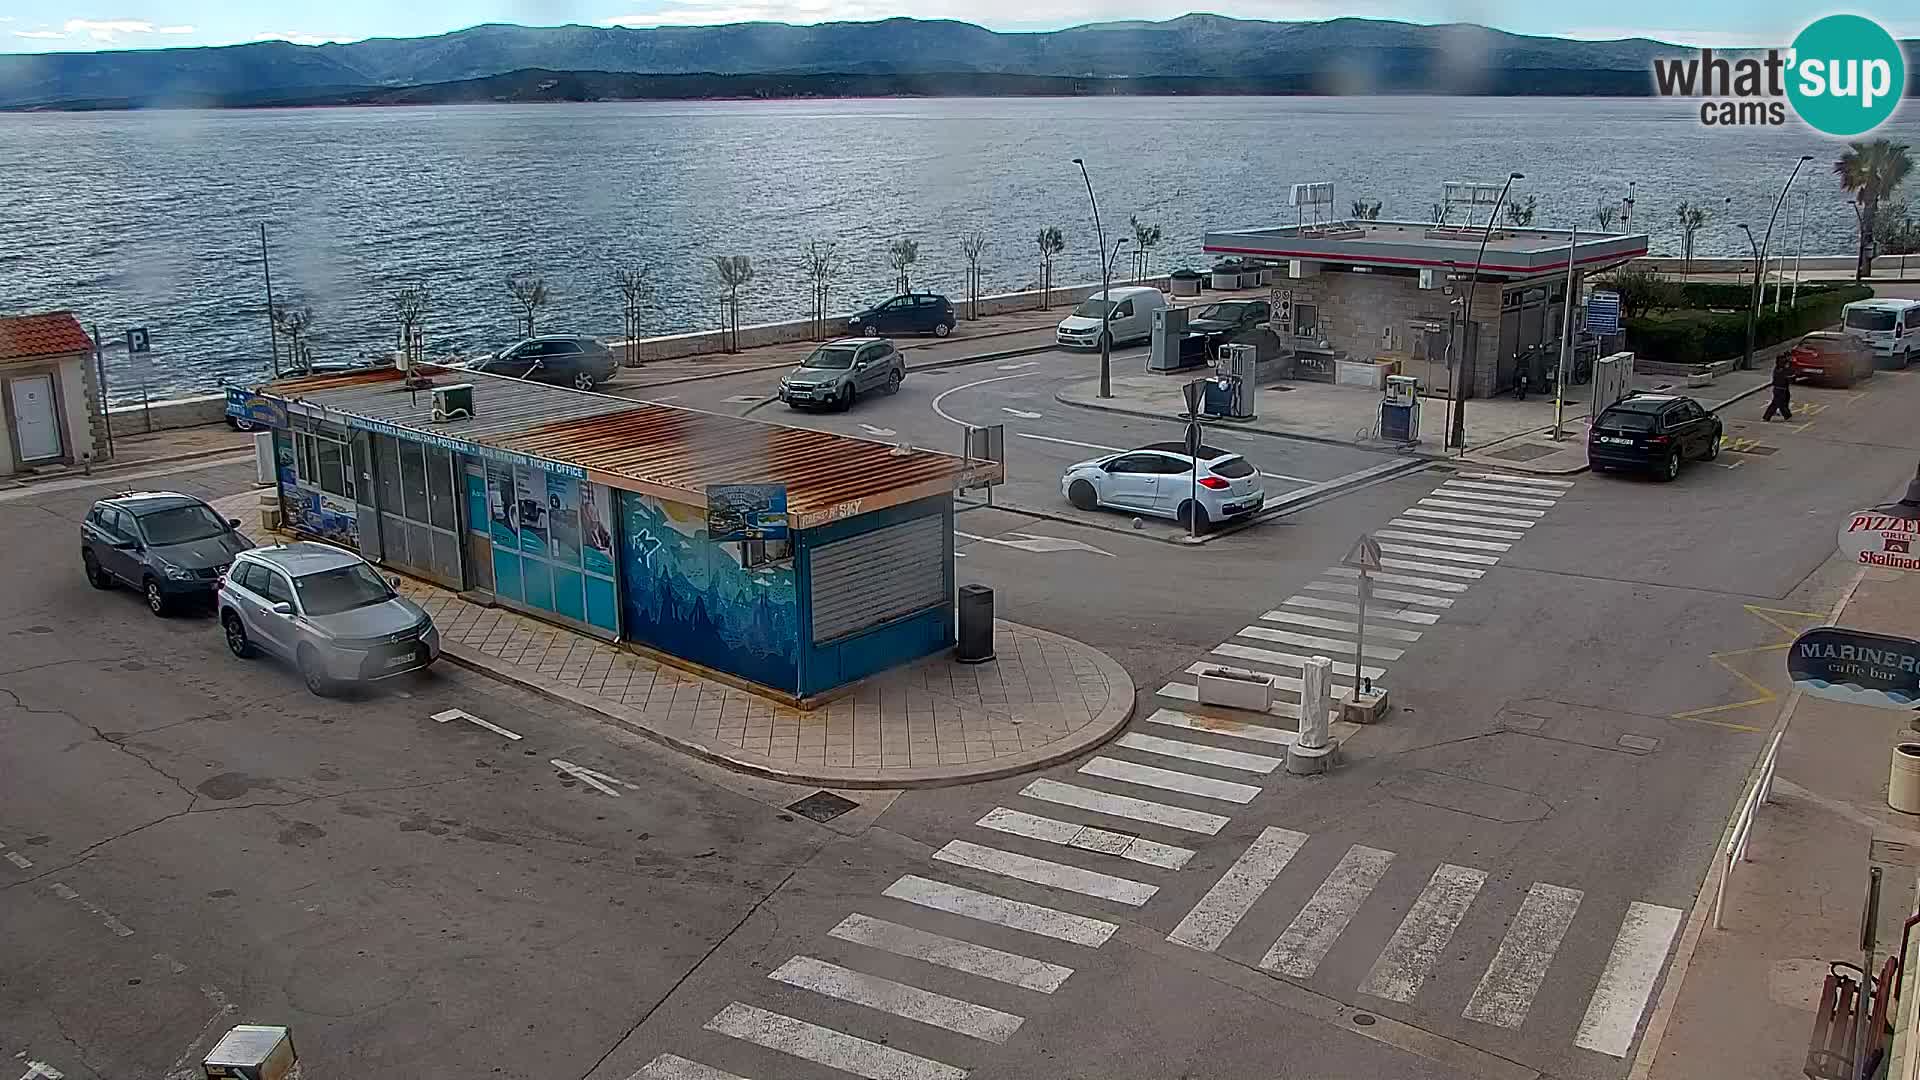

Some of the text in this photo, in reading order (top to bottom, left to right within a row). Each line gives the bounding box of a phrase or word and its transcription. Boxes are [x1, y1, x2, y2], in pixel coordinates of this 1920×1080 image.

[132, 332, 144, 350] P
[437, 438, 468, 452] POSTAJA
[529, 457, 554, 472] TICKET
[555, 463, 583, 478] OFFICE
[1881, 532, 1916, 542] GRILL
[1870, 666, 1896, 681] bar
